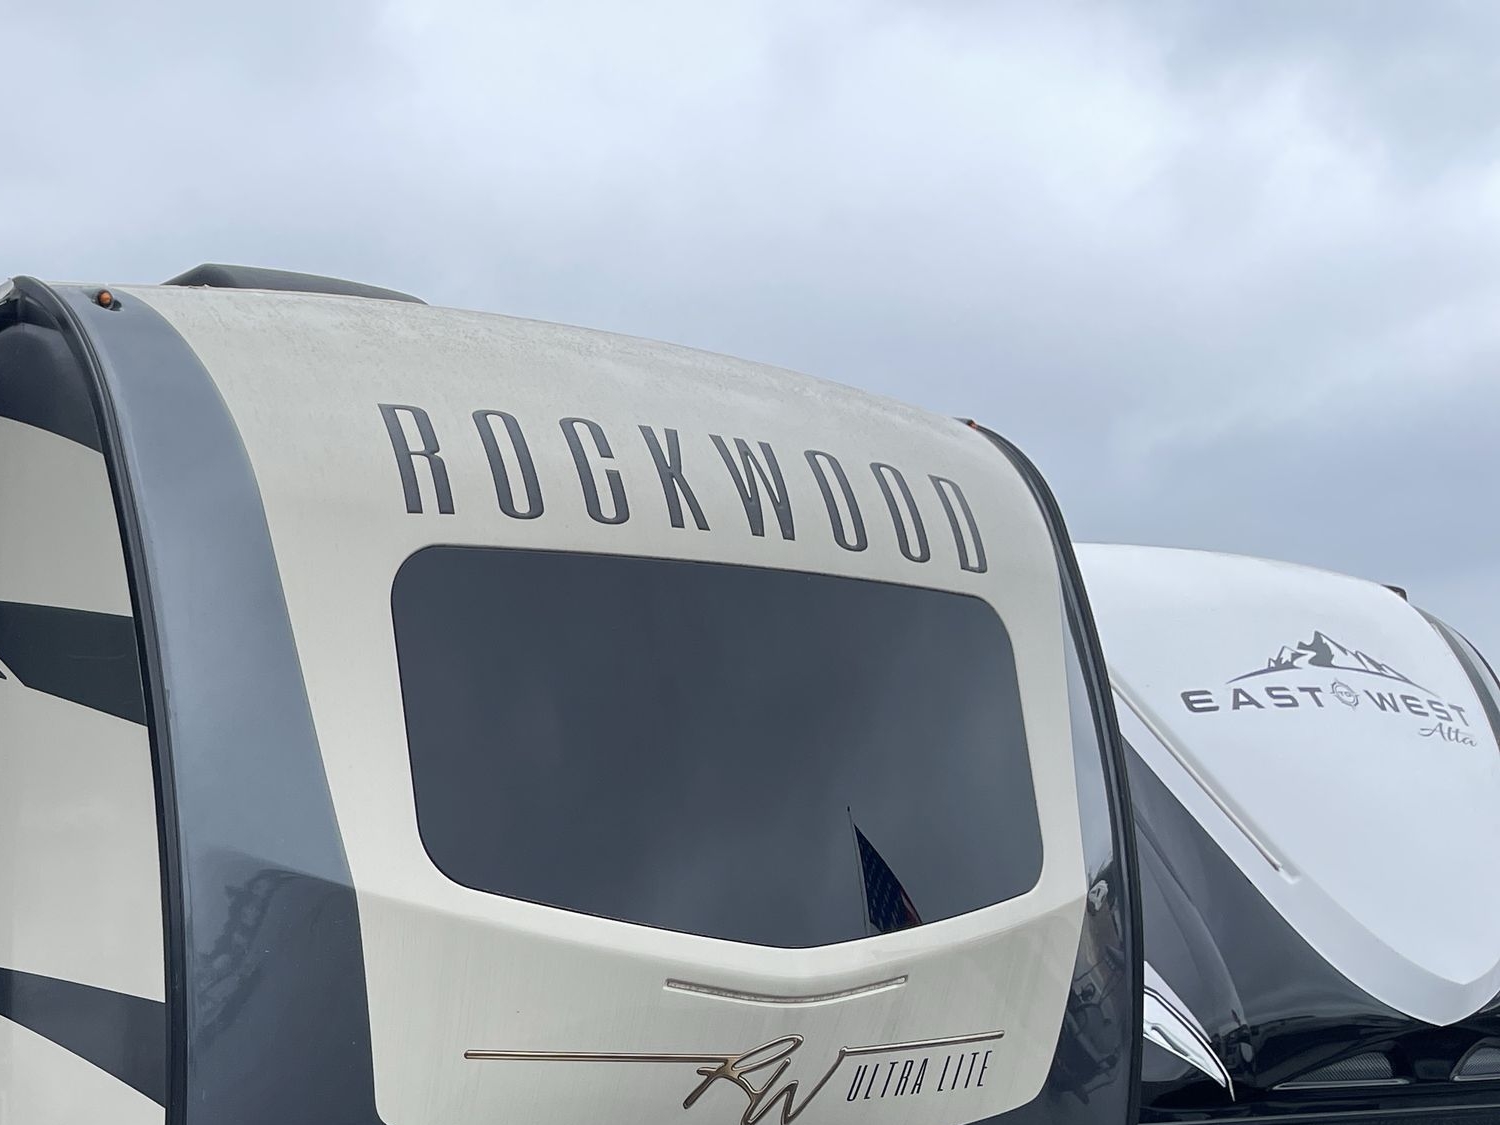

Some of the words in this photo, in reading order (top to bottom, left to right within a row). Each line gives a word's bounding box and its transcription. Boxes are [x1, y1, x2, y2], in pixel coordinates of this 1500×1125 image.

[377, 403, 988, 574] ROCKWOOD
[1180, 686, 1326, 713] EAST
[1362, 689, 1470, 727] WEST
[1417, 721, 1478, 748] Alta
[846, 1057, 929, 1102] ULTRA
[936, 1050, 993, 1092] LITE
